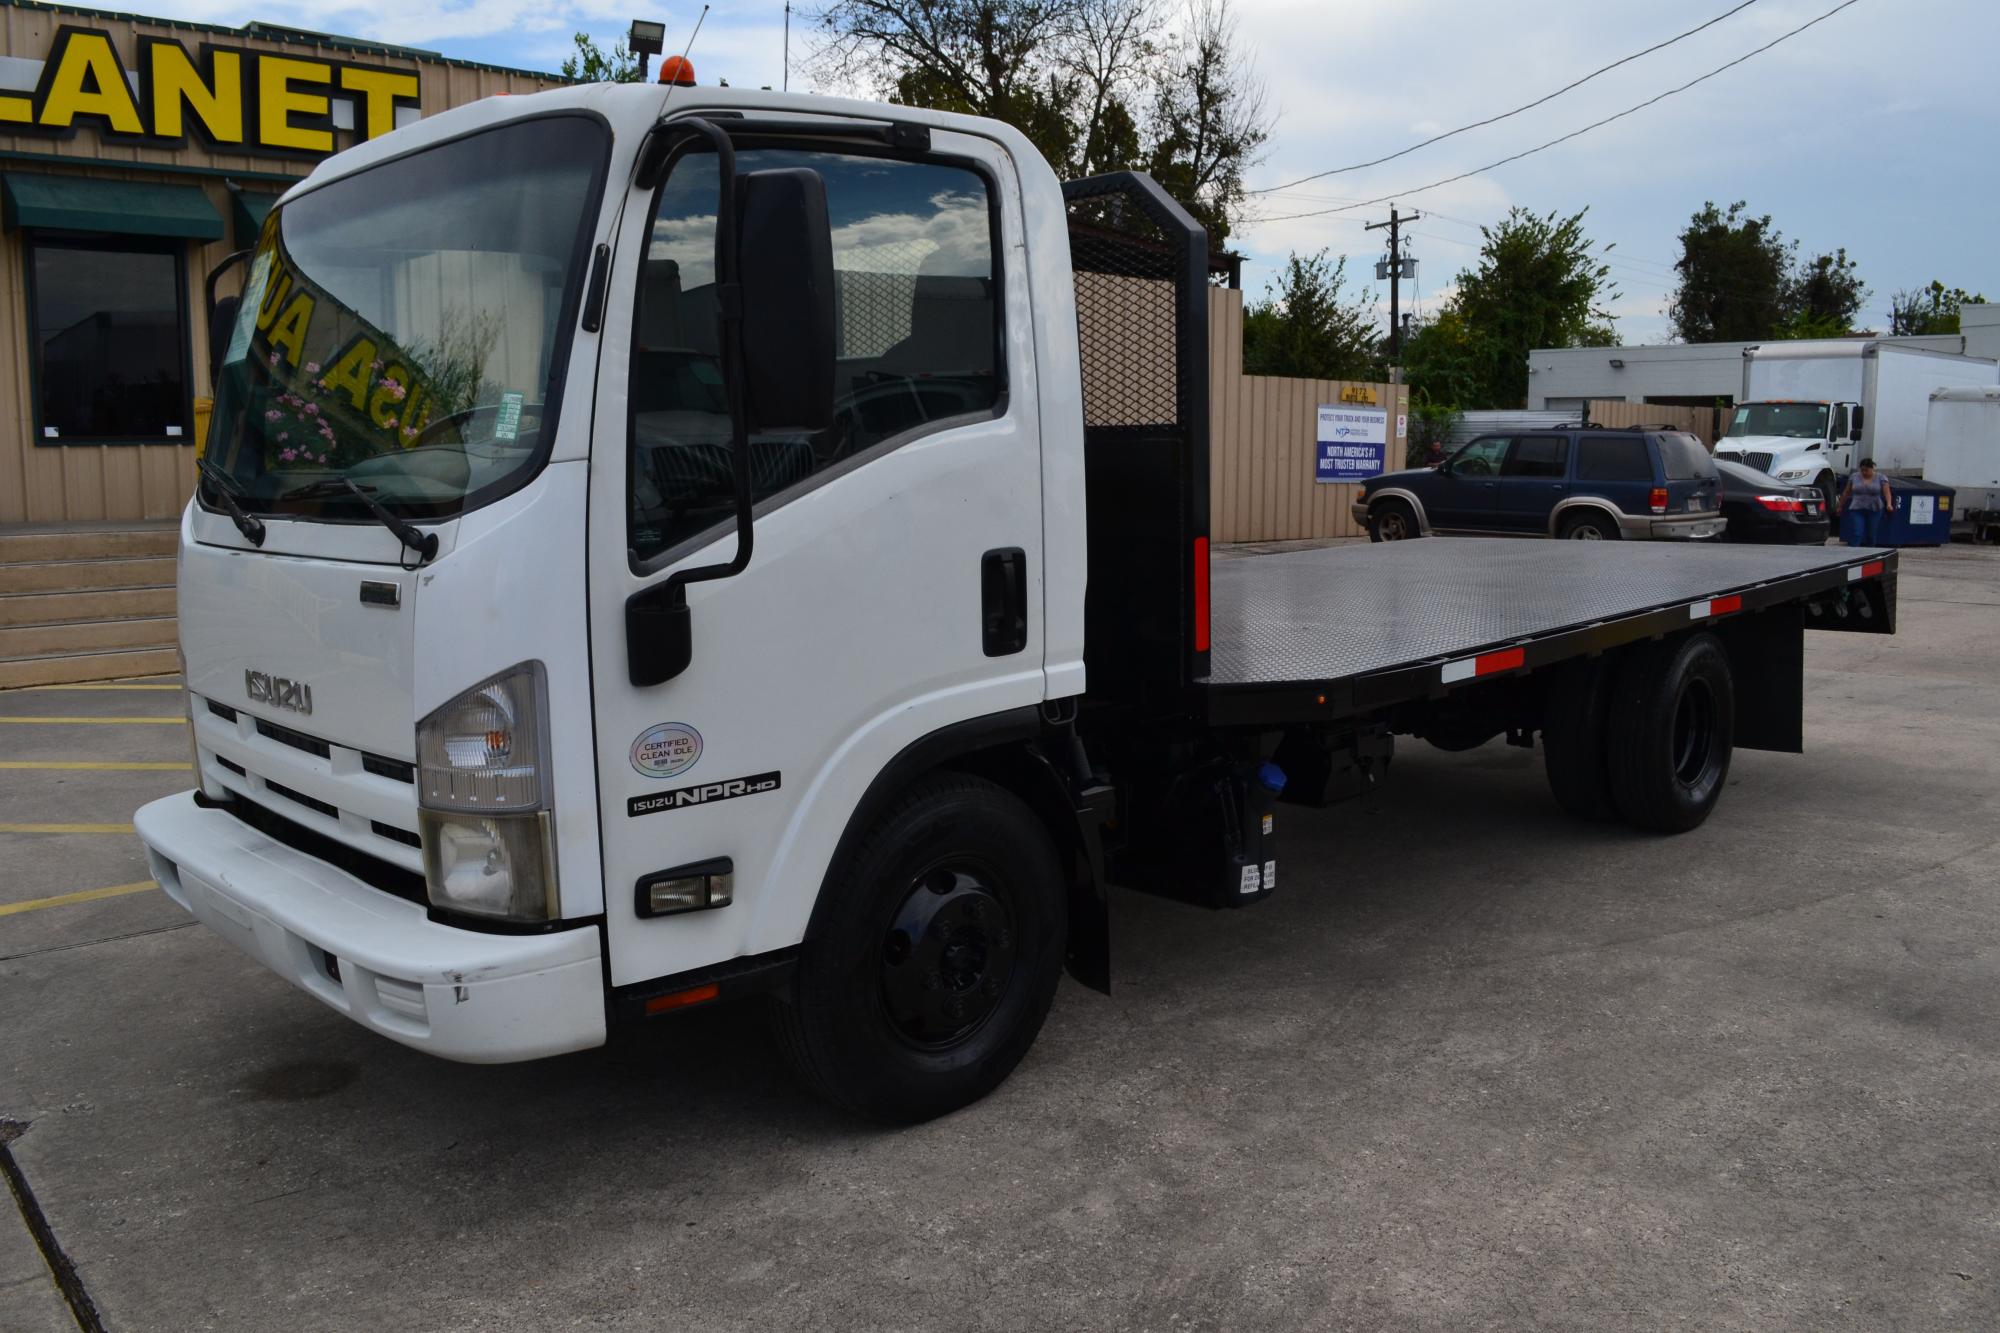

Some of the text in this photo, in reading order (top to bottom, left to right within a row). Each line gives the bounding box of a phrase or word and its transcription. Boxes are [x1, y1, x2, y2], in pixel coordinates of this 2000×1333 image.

[1327, 446, 1343, 457] NORTH
[1344, 446, 1368, 458] AMERICA'S
[1320, 458, 1381, 471] MOST TRUSTED WARRANTY
[245, 668, 313, 715] ISUZU
[644, 738, 689, 752] CERTIFIED
[640, 749, 670, 761] CLEAN
[673, 746, 693, 756] IDLE
[633, 796, 674, 812] ISUZU
